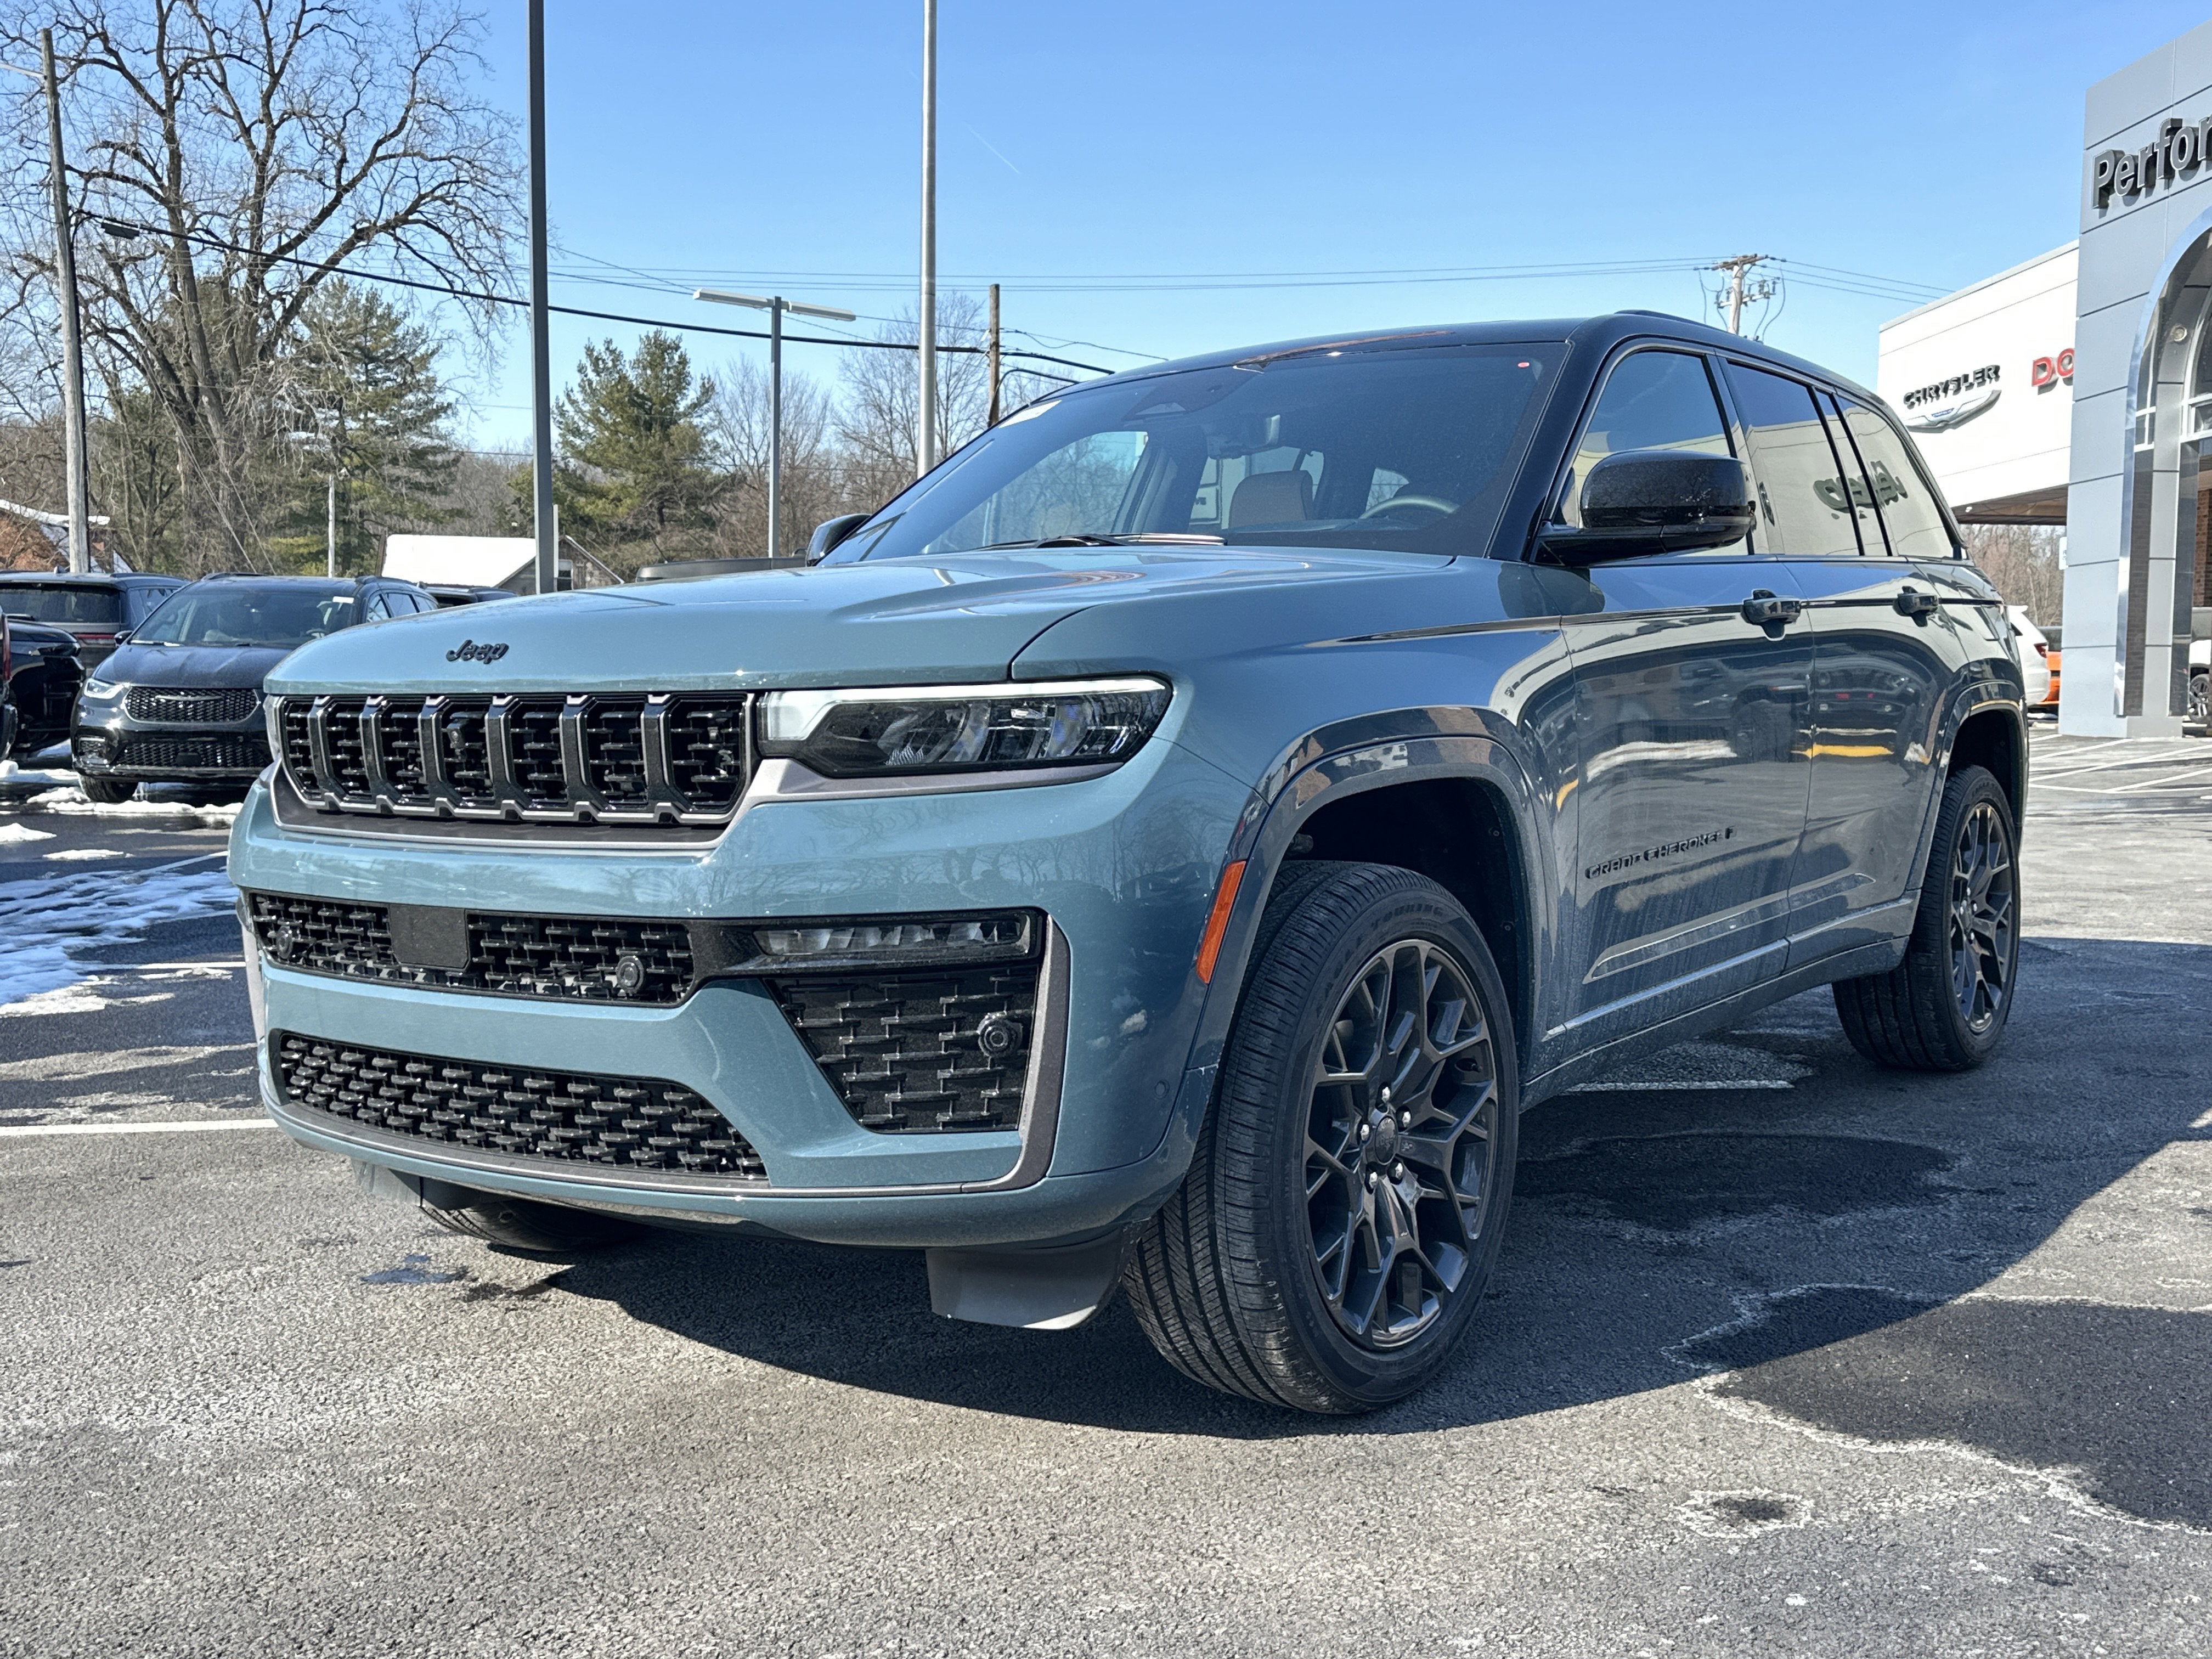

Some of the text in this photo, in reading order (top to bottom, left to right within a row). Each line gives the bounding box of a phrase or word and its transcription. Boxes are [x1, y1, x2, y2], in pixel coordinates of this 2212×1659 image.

[1903, 365, 2000, 406] CHRYSLER
[446, 639, 510, 665] Jeep
[1585, 854, 1641, 879] GRAND
